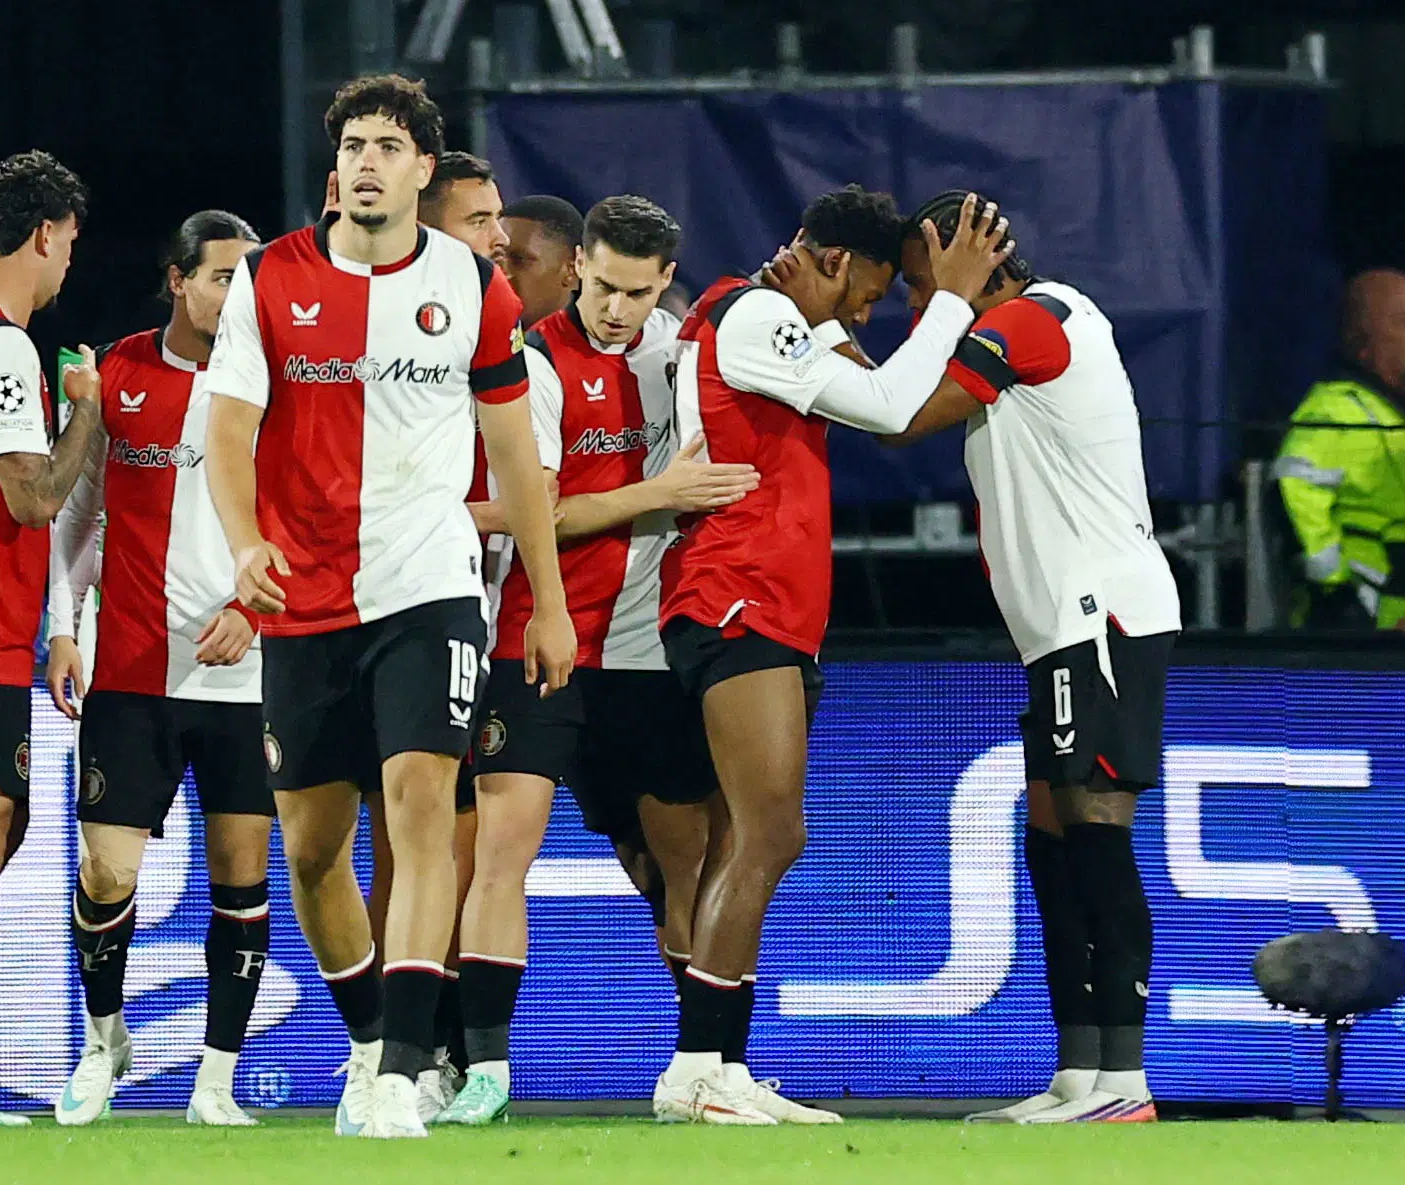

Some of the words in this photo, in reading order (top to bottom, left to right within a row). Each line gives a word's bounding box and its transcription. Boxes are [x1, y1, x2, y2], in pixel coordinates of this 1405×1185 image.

[284, 355, 354, 384] Media
[378, 357, 451, 385] Markt
[567, 428, 644, 456] Media
[447, 639, 478, 704] 19
[1053, 667, 1073, 726] 6
[233, 950, 268, 979] F
